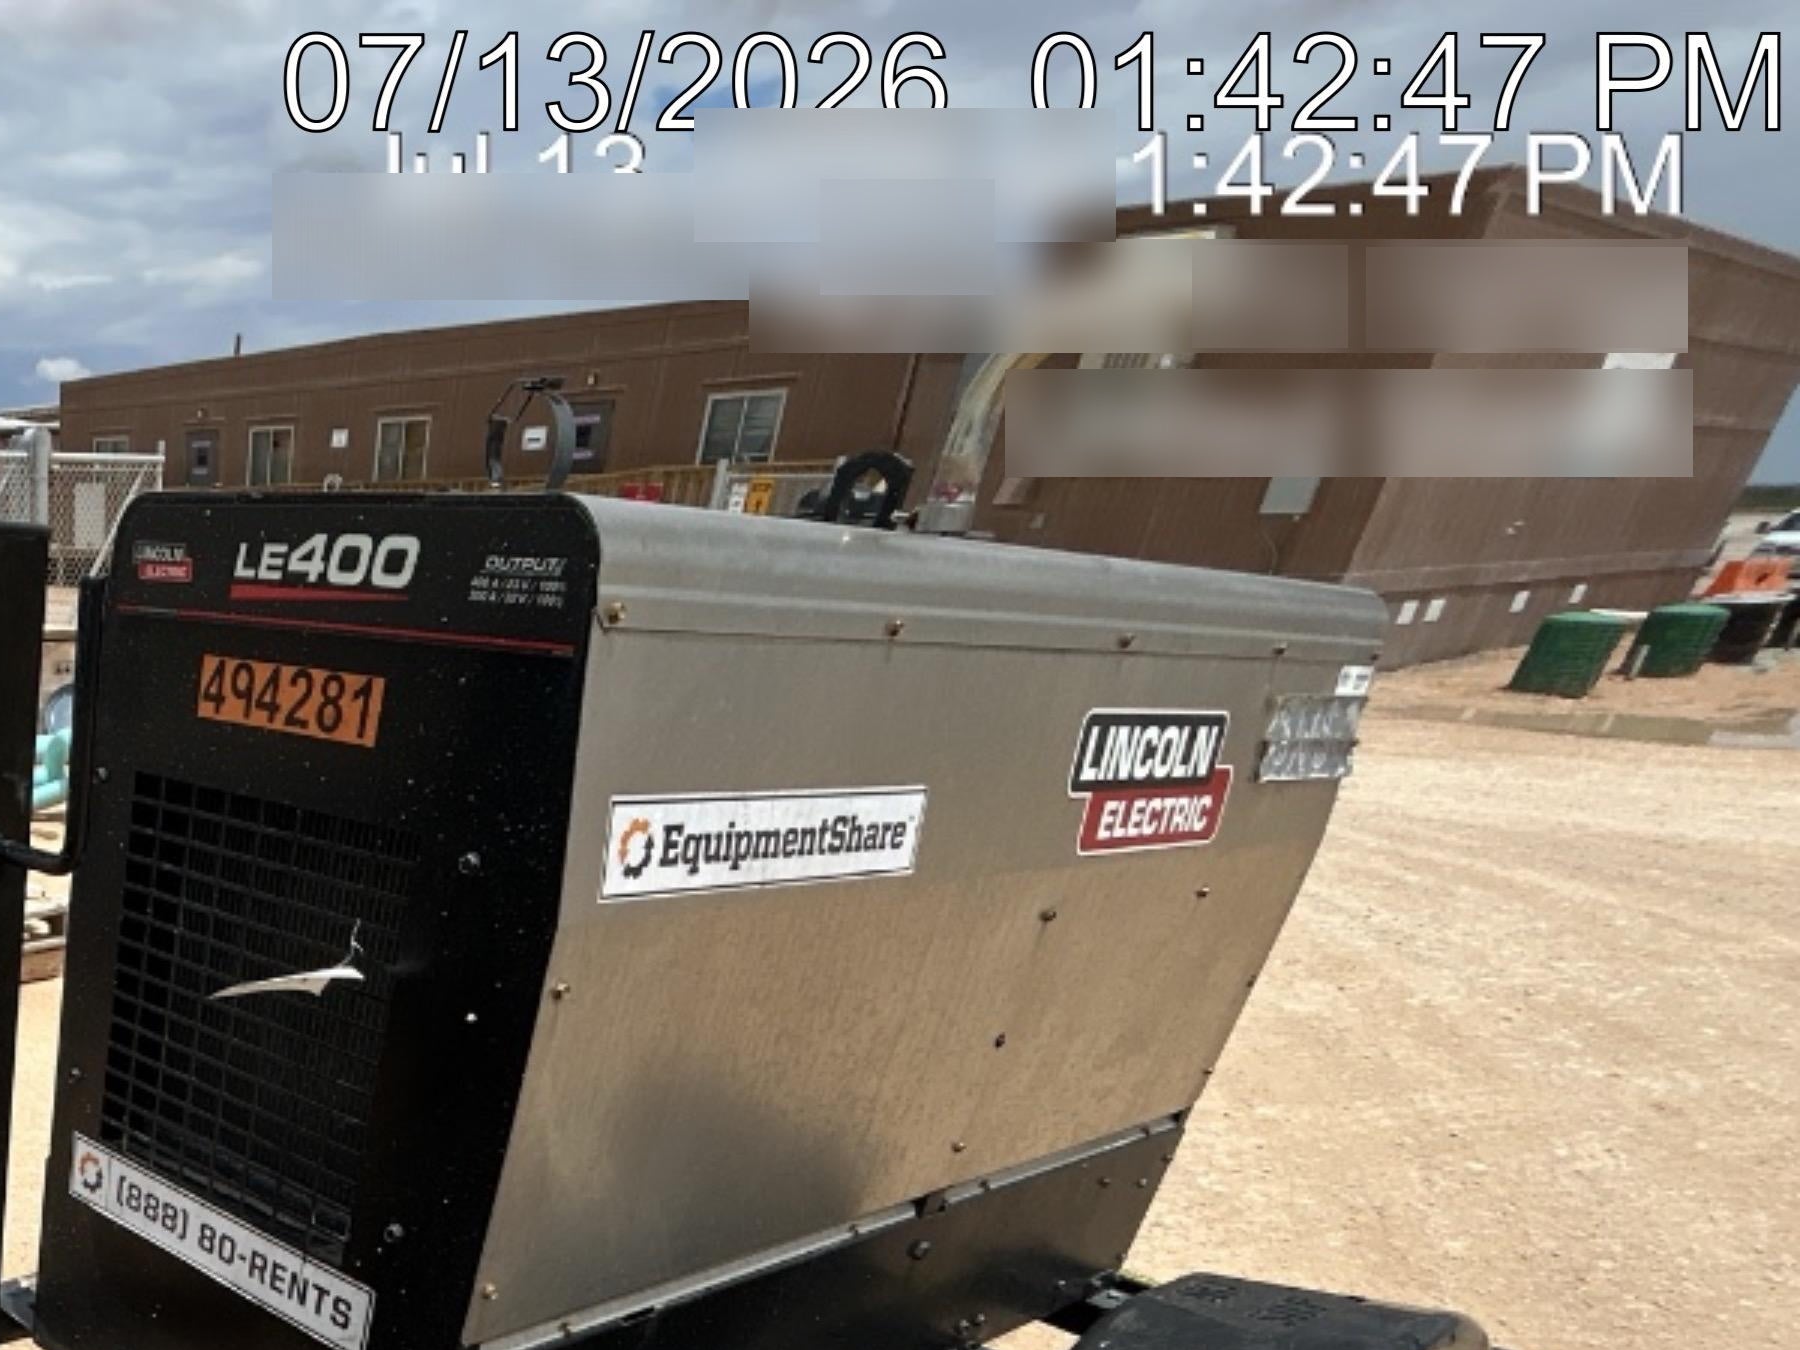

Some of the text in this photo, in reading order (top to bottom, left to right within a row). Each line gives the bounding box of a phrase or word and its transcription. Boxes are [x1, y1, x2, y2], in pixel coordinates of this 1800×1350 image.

[233, 532, 421, 589] LE400
[201, 656, 374, 739] 494281
[1079, 725, 1219, 781] LINCOLN
[658, 814, 908, 876] EquipmentShare
[1096, 794, 1213, 841] ELECTRIC
[116, 1174, 190, 1241] (888)
